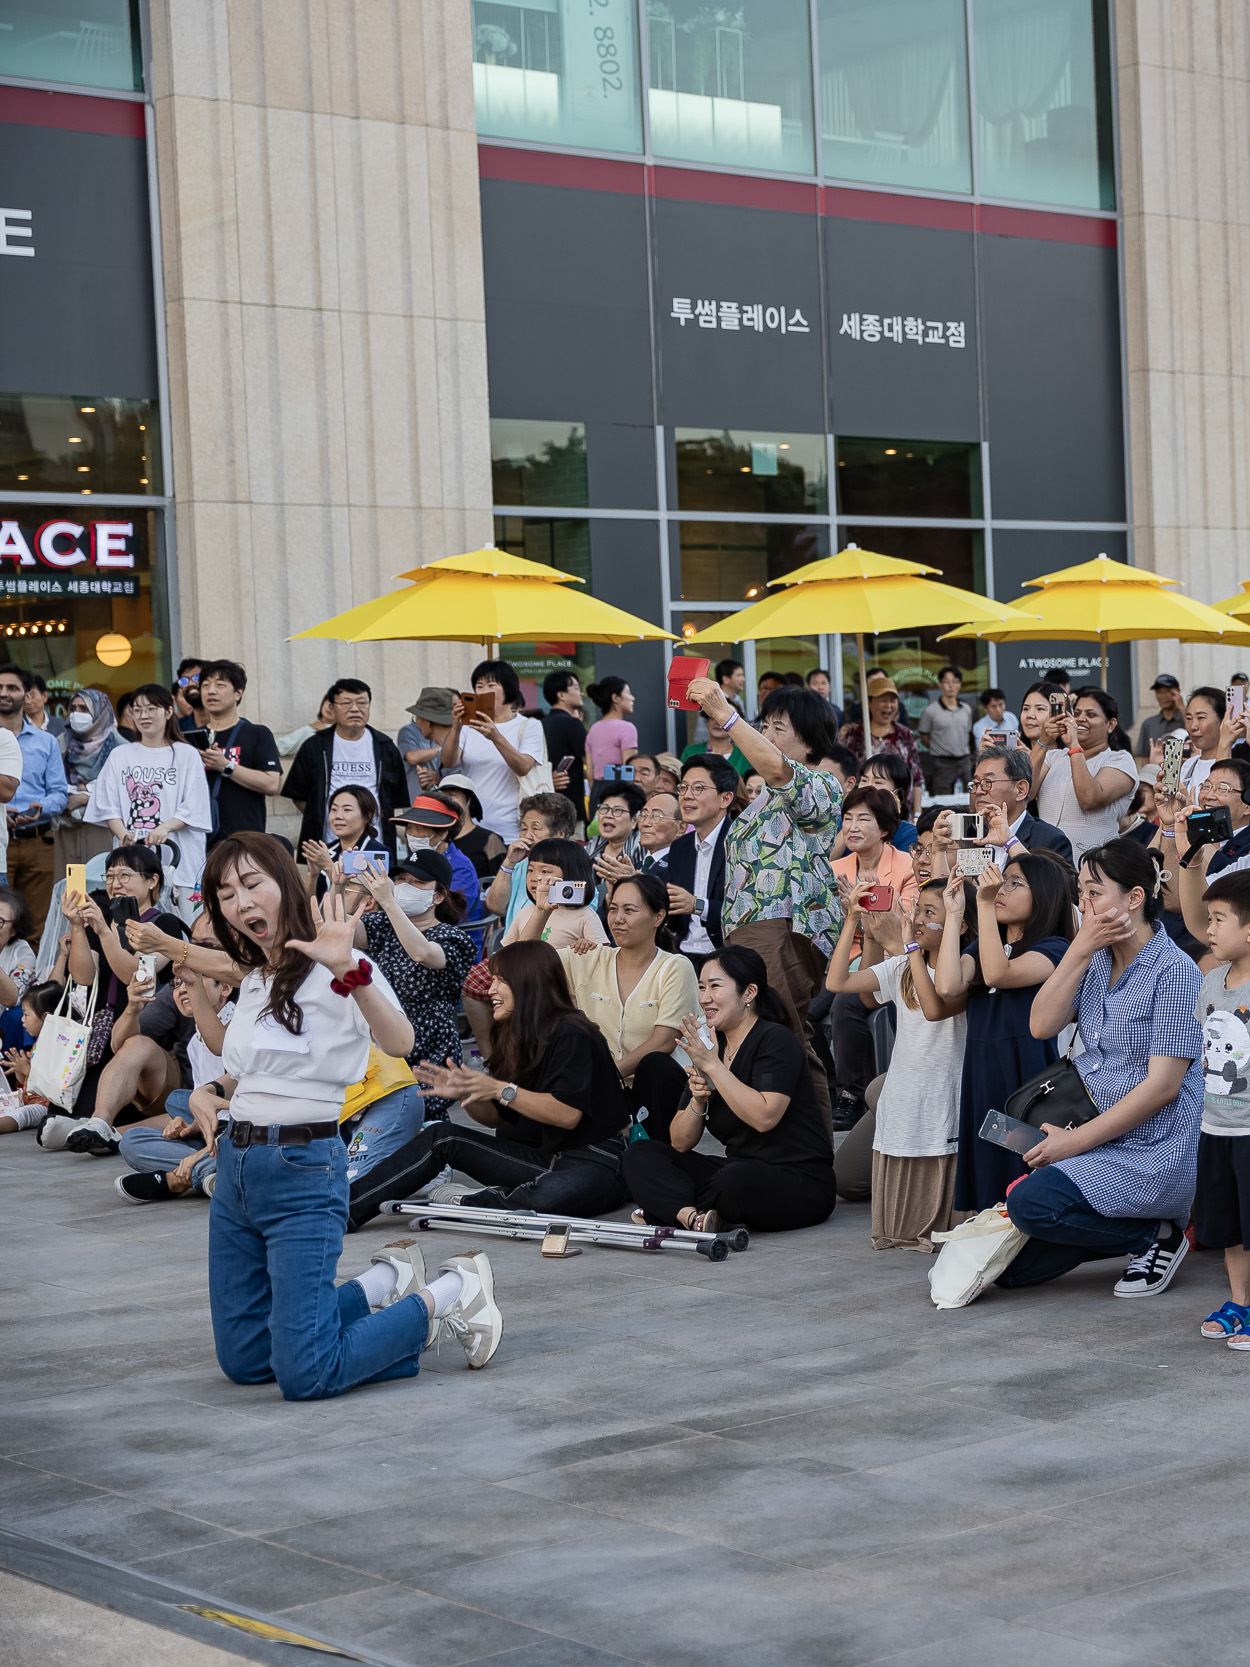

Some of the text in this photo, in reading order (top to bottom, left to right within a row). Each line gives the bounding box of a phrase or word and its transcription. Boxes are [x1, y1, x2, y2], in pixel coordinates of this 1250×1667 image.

[670, 297, 967, 349] 투썸플레이스 세종대학교점
[67, 580, 135, 594] 세종대학교점
[1019, 658, 1028, 669] A
[1027, 657, 1077, 669] TWOSOME
[332, 763, 372, 773] GUESS
